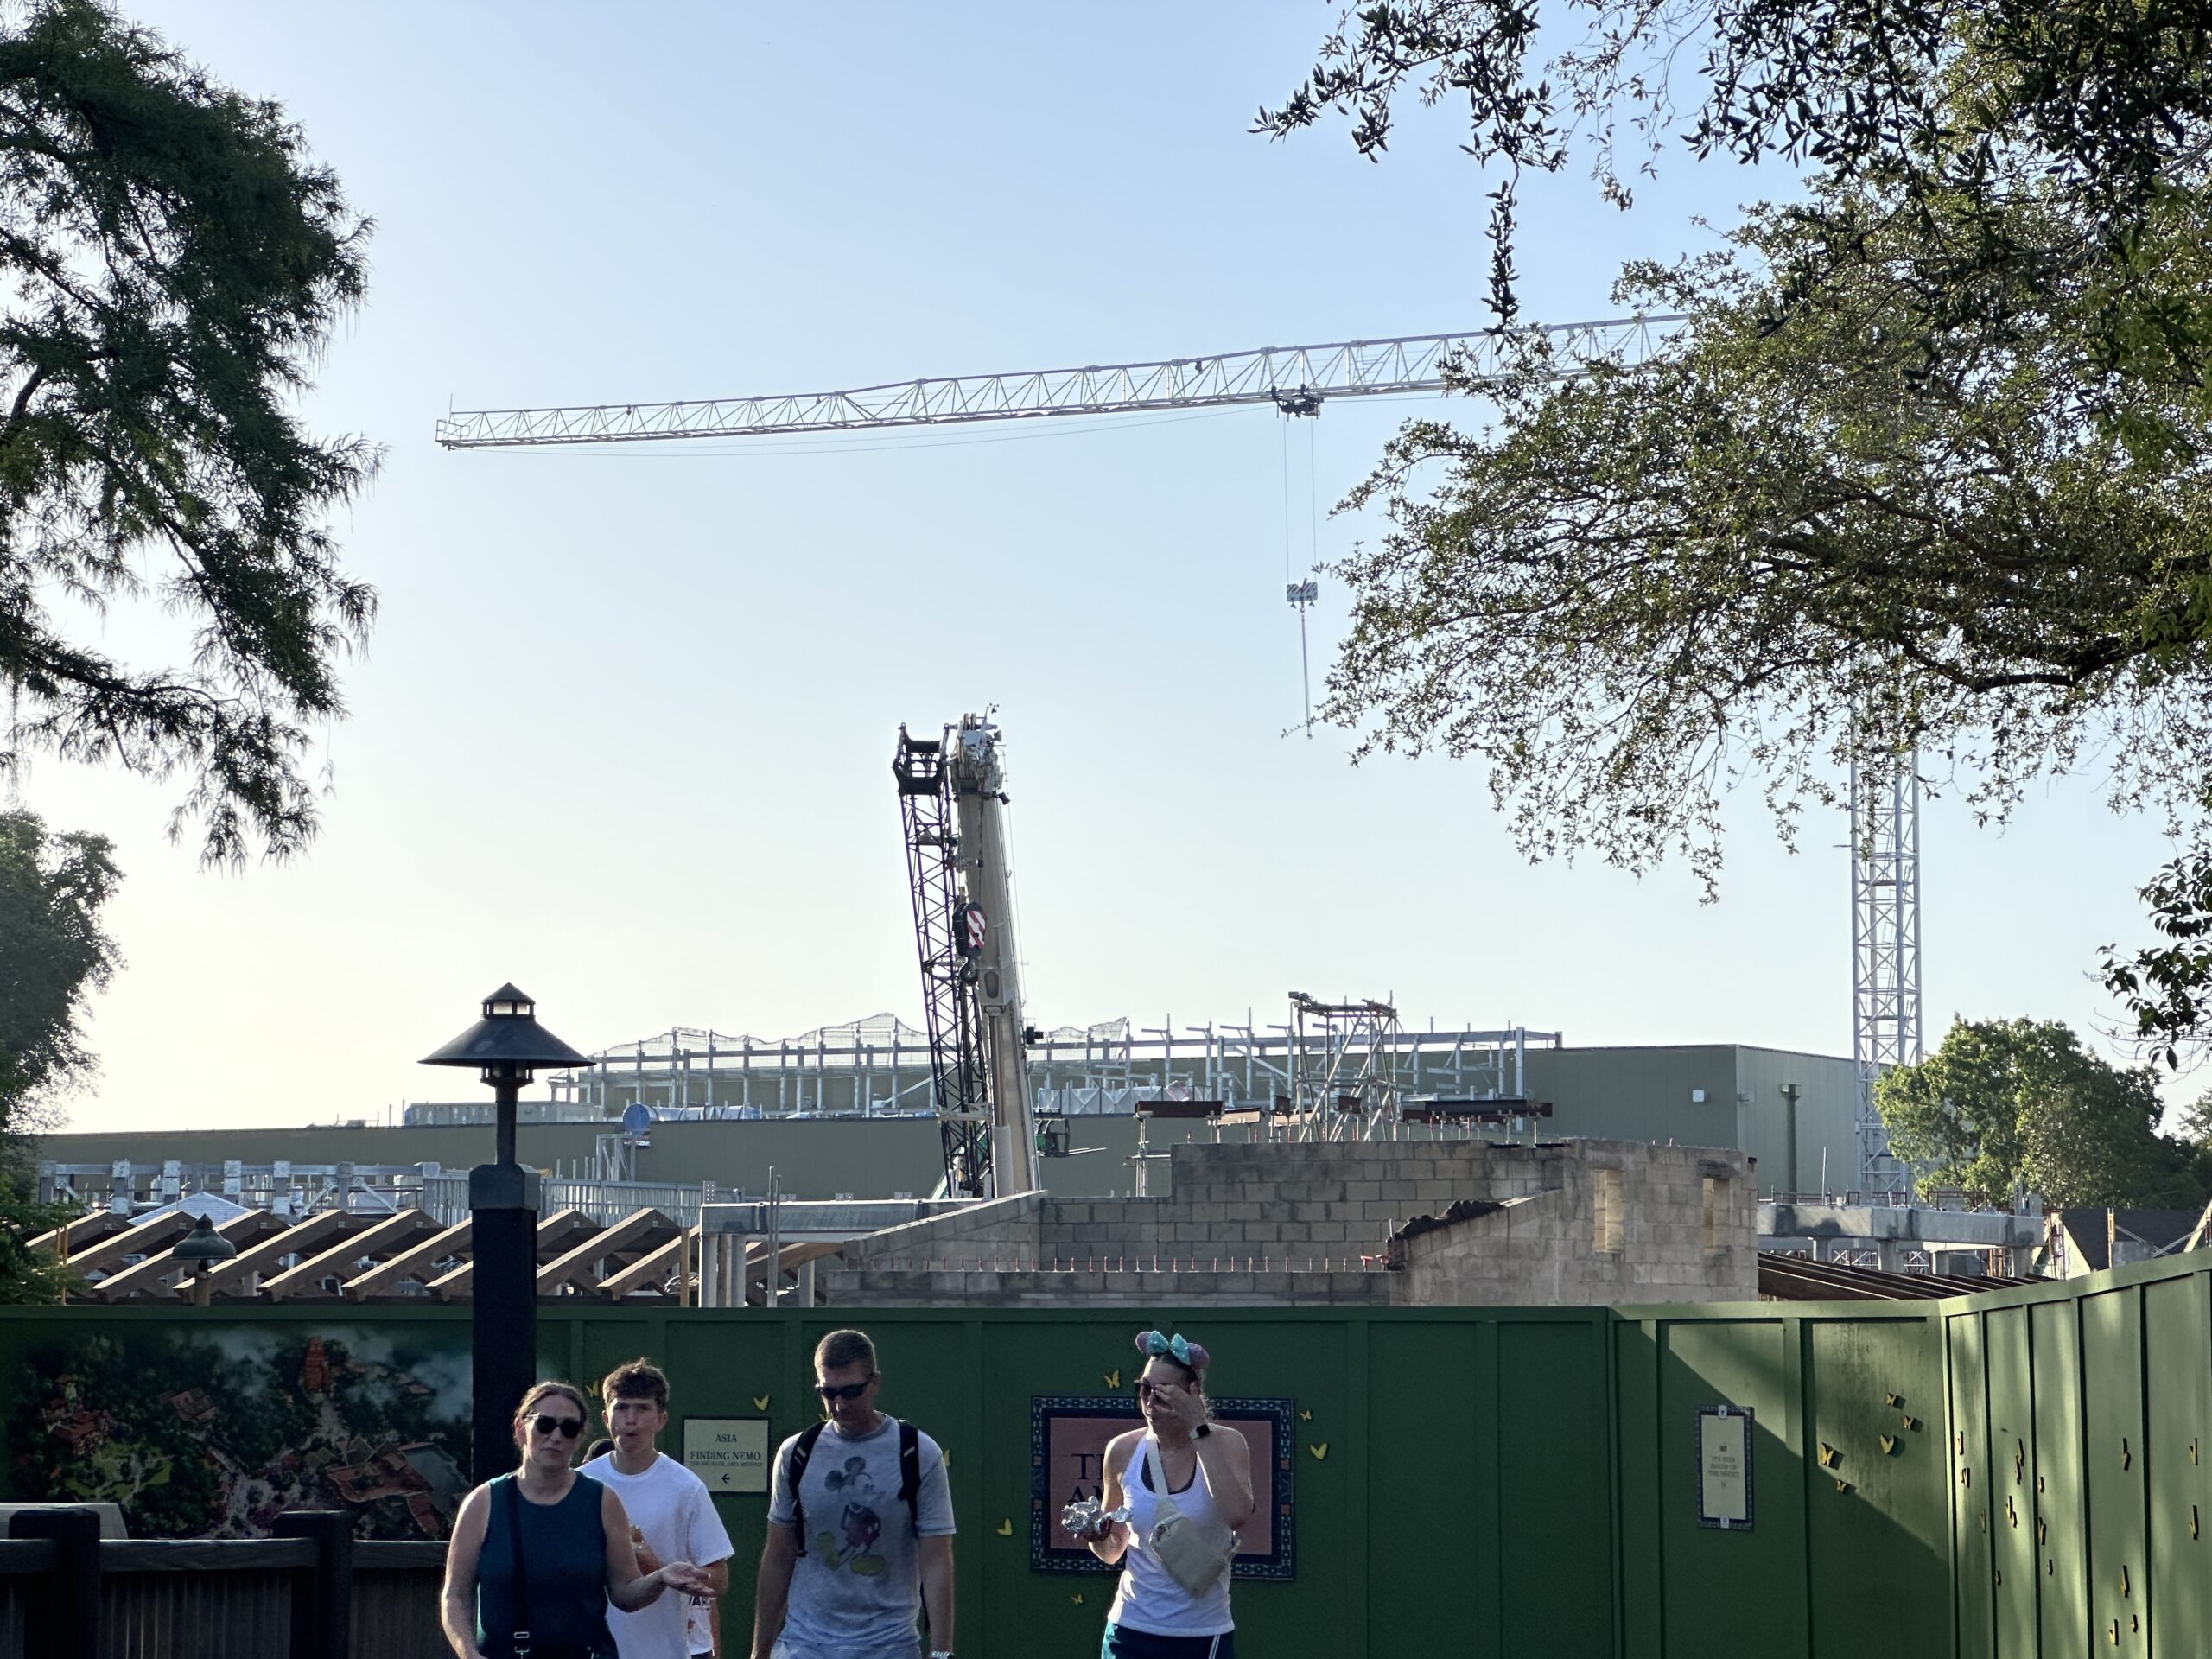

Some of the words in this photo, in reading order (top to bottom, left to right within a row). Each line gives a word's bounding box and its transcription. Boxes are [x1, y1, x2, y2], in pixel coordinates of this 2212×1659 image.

[715, 1433, 737, 1442] ASIA
[690, 1451, 730, 1460] FINDING
[733, 1452, 761, 1460] NEMO
[1071, 1453, 1103, 1480] T
